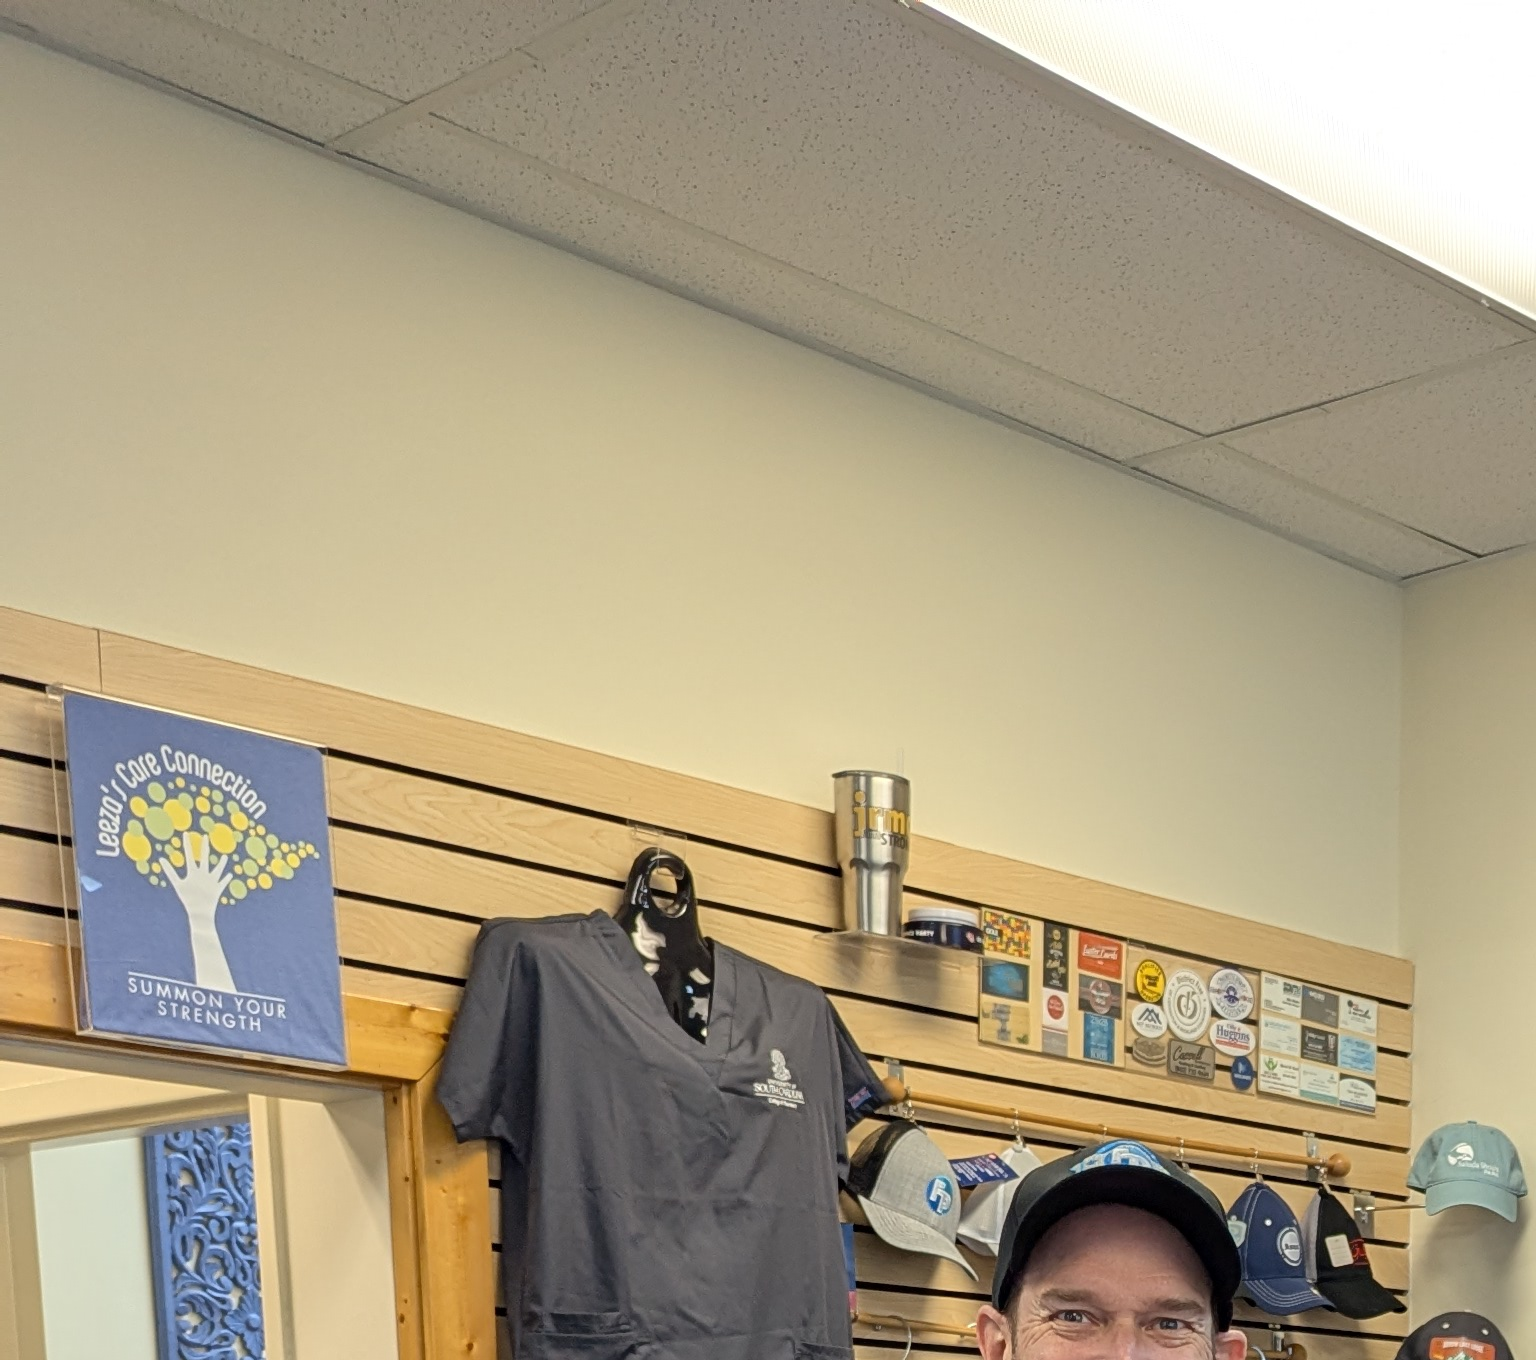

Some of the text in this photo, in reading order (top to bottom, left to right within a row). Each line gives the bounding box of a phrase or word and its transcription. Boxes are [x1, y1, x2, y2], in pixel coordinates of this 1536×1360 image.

[115, 752, 161, 788] Care
[160, 744, 267, 819] Connection
[853, 790, 910, 838] jrm
[881, 833, 909, 849] STRO
[128, 977, 287, 1019] SUMMON YOUR
[157, 1001, 262, 1032] STRENGTH
[1216, 1024, 1250, 1043] Huggins
